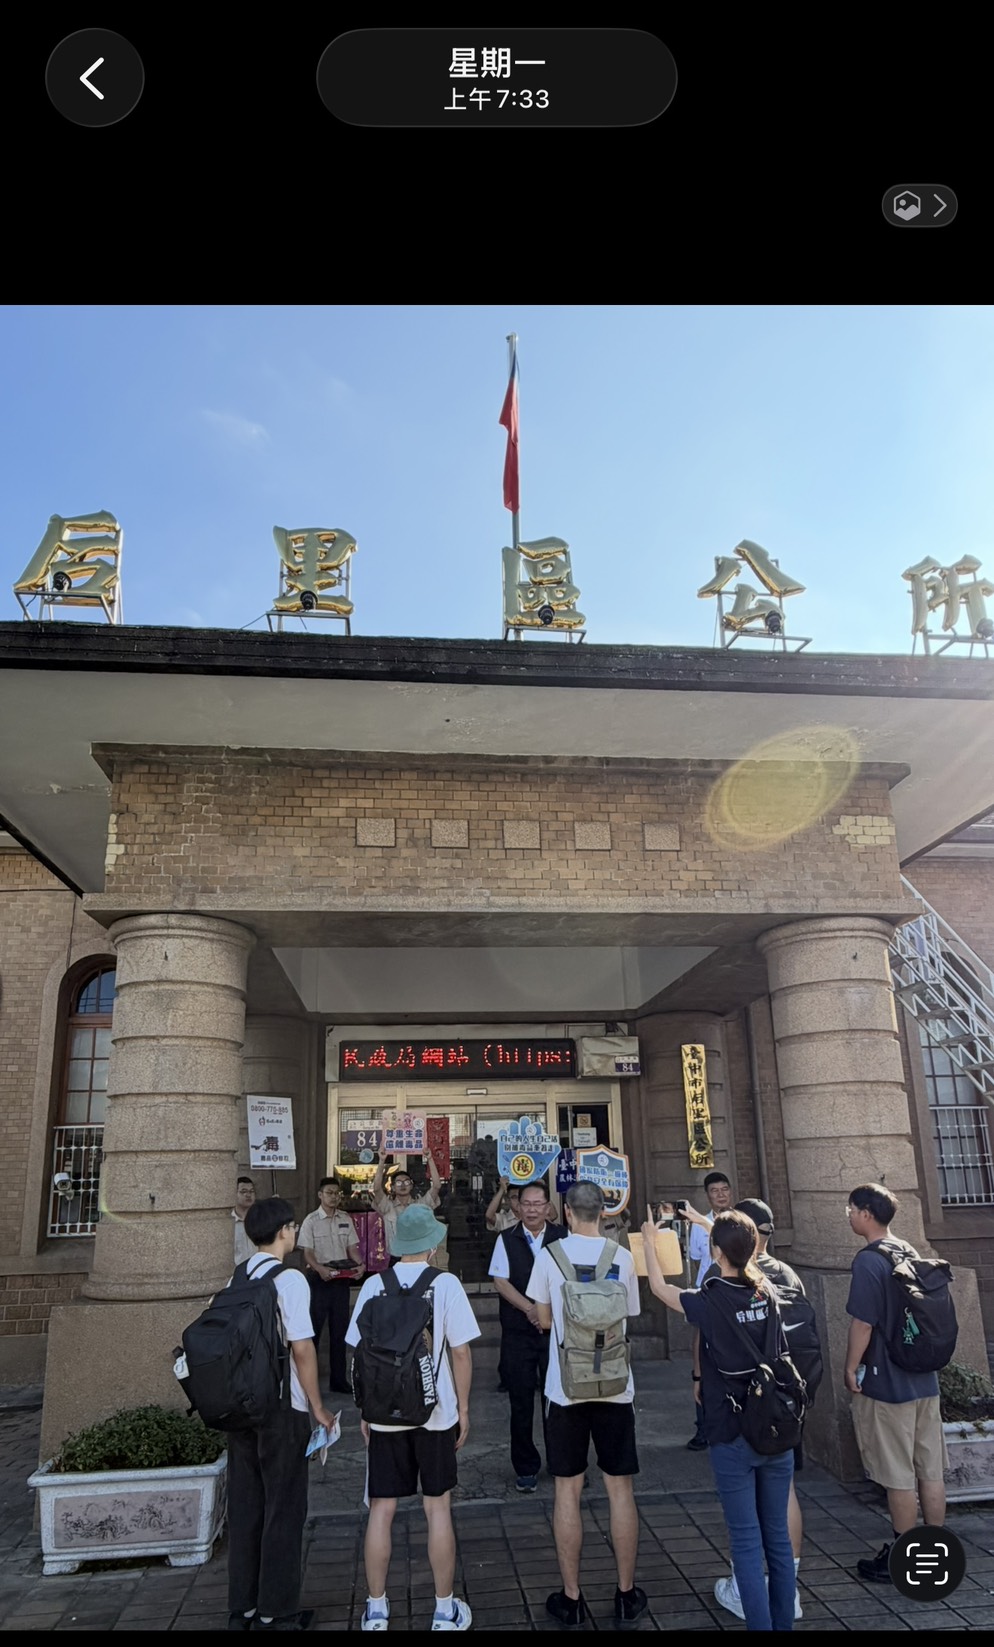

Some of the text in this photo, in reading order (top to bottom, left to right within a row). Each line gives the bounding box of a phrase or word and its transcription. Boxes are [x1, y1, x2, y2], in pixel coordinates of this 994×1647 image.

[14, 508, 994, 640] 后里區公所
[622, 1063, 634, 1072] 84
[357, 1131, 378, 1147] 84
[386, 1129, 423, 1138] 尊重生命
[385, 1139, 423, 1149] 遠離毒品
[418, 1354, 436, 1406] FASHION
